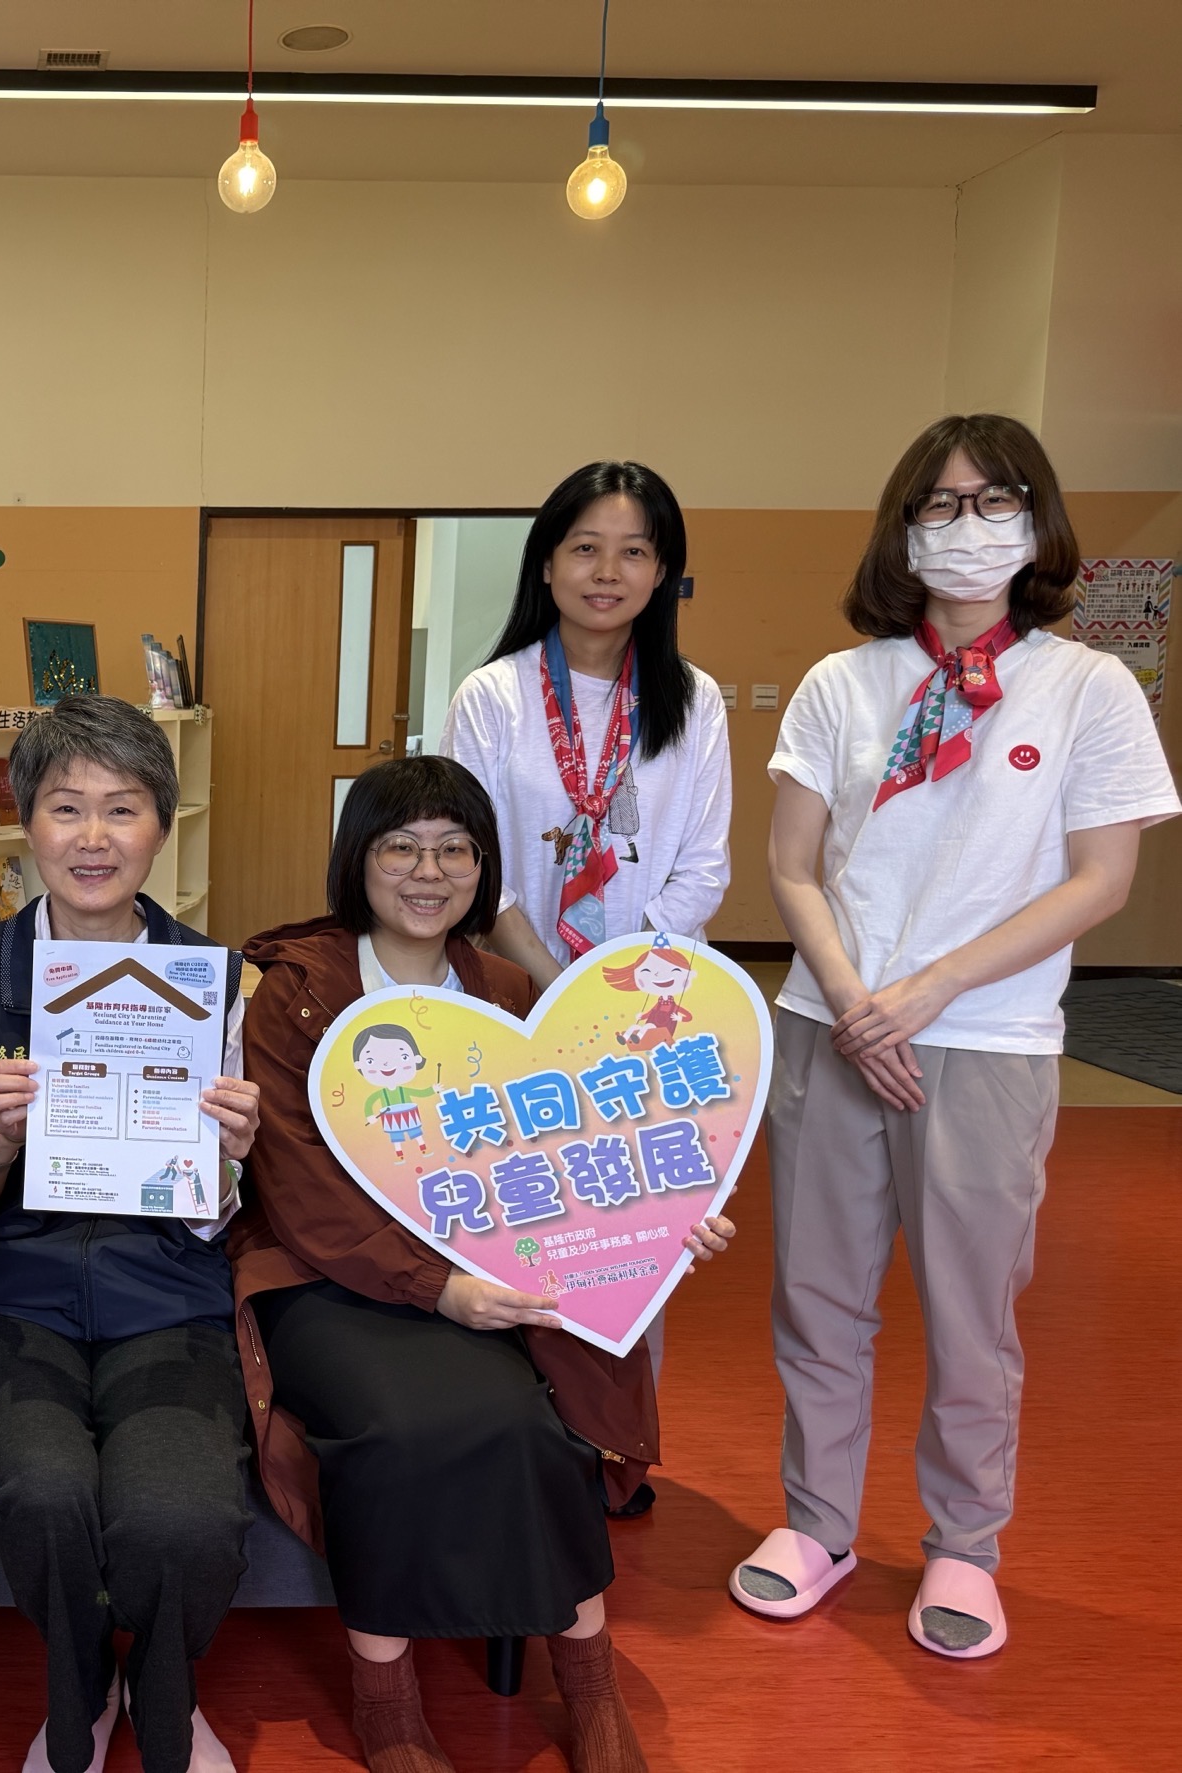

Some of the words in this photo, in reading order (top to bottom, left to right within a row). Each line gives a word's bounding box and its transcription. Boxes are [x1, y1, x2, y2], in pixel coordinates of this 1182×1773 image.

[49, 966, 72, 974] 免費申請
[86, 1002, 171, 1013] 基隆市育兒指導到你家
[437, 1033, 730, 1152] 共同守護
[419, 1119, 716, 1241] 兒童發展
[542, 1227, 596, 1248] 基隆市政府
[547, 1234, 632, 1261] 兒童及少年事務處
[629, 1258, 655, 1266] FOUNDATION
[566, 1263, 658, 1291] 伊甸社會福利基金會
